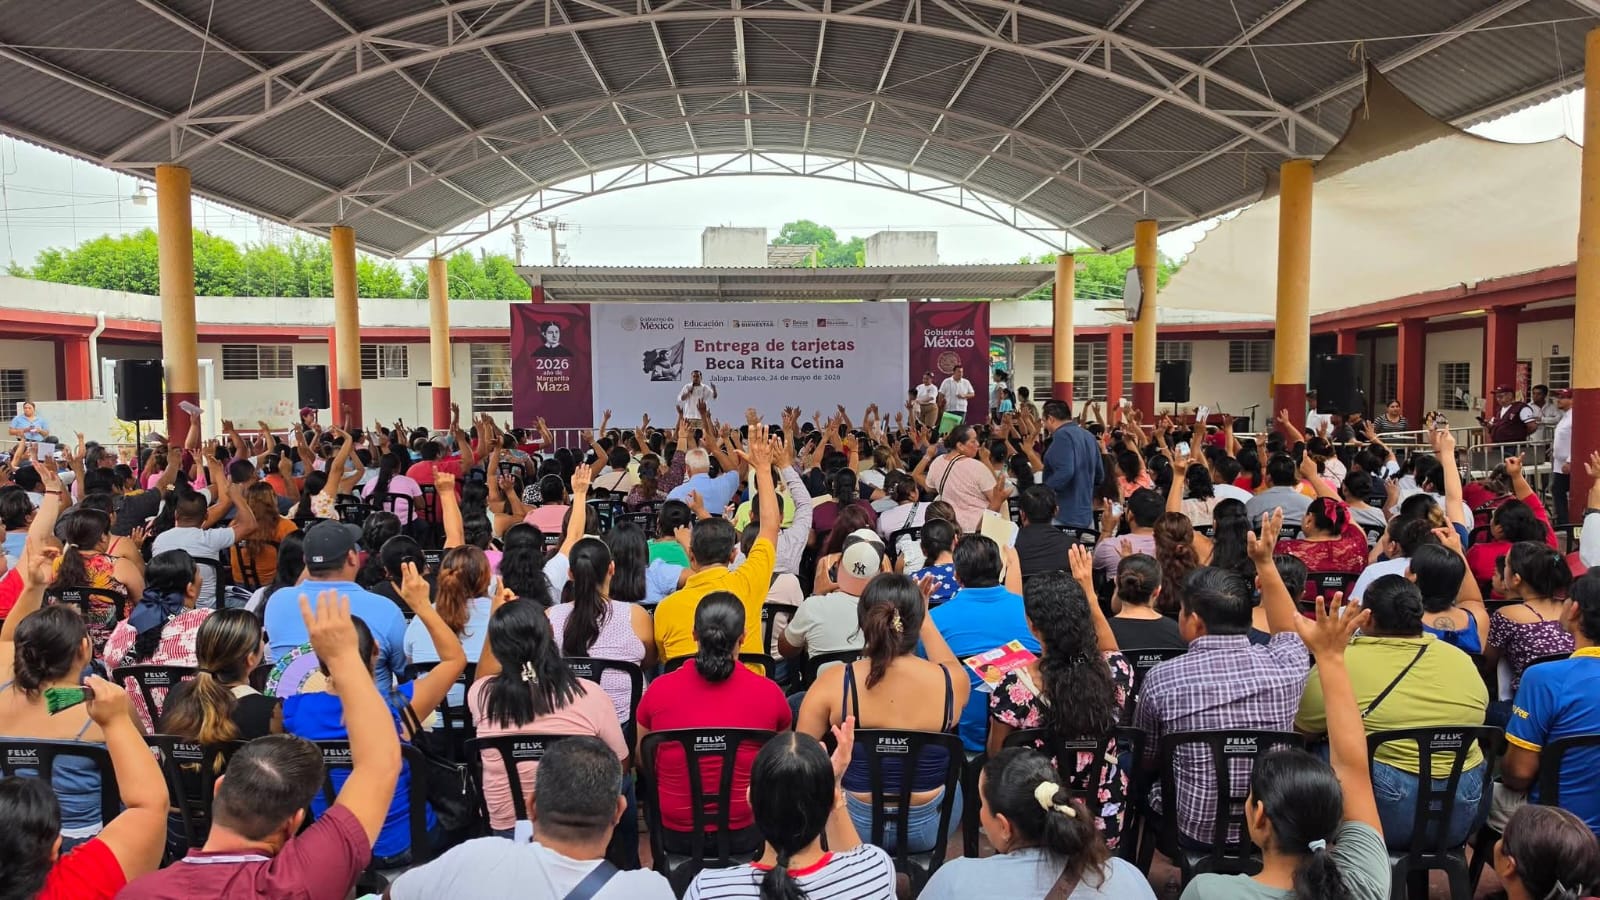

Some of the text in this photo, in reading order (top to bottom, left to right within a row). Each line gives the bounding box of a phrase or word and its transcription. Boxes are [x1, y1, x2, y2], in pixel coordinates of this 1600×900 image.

[639, 321, 674, 330] México
[684, 319, 724, 328] Educación
[923, 328, 975, 336] Gobierno de
[923, 335, 975, 348] México
[694, 338, 855, 355] Entrega de tarjetas
[536, 359, 569, 370] 2026
[705, 356, 844, 370] Beca Rita Cetina
[709, 375, 735, 383] Jalapa,
[791, 375, 811, 383] mayo
[536, 381, 570, 392] Maza
[696, 734, 726, 743] FELIX
[878, 737, 910, 745] FELIX
[1226, 737, 1258, 745] FELIX
[513, 742, 543, 750] FELIX
